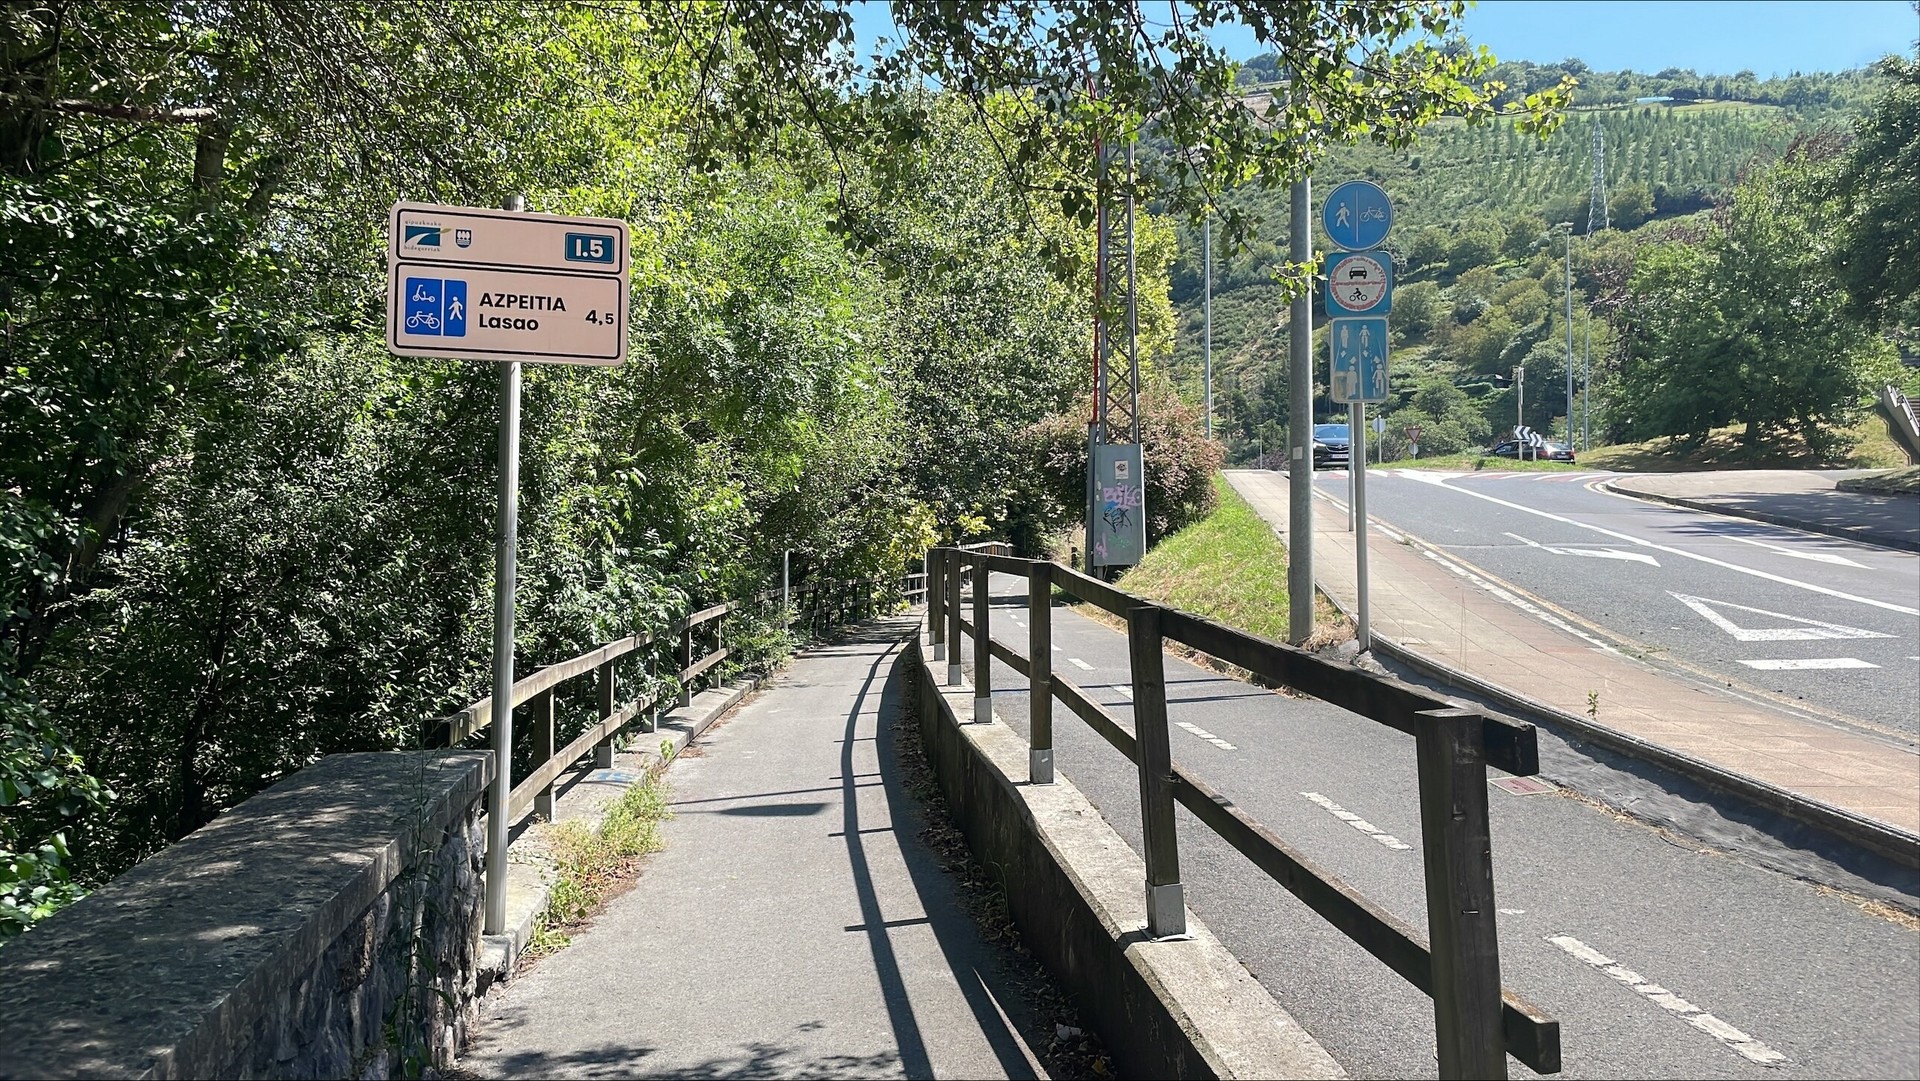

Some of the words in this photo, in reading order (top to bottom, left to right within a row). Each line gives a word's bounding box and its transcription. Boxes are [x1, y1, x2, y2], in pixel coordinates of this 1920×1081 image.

[479, 292, 567, 312] AZPEITIA
[479, 313, 539, 331] Lasao
[585, 309, 615, 326] 4,5
